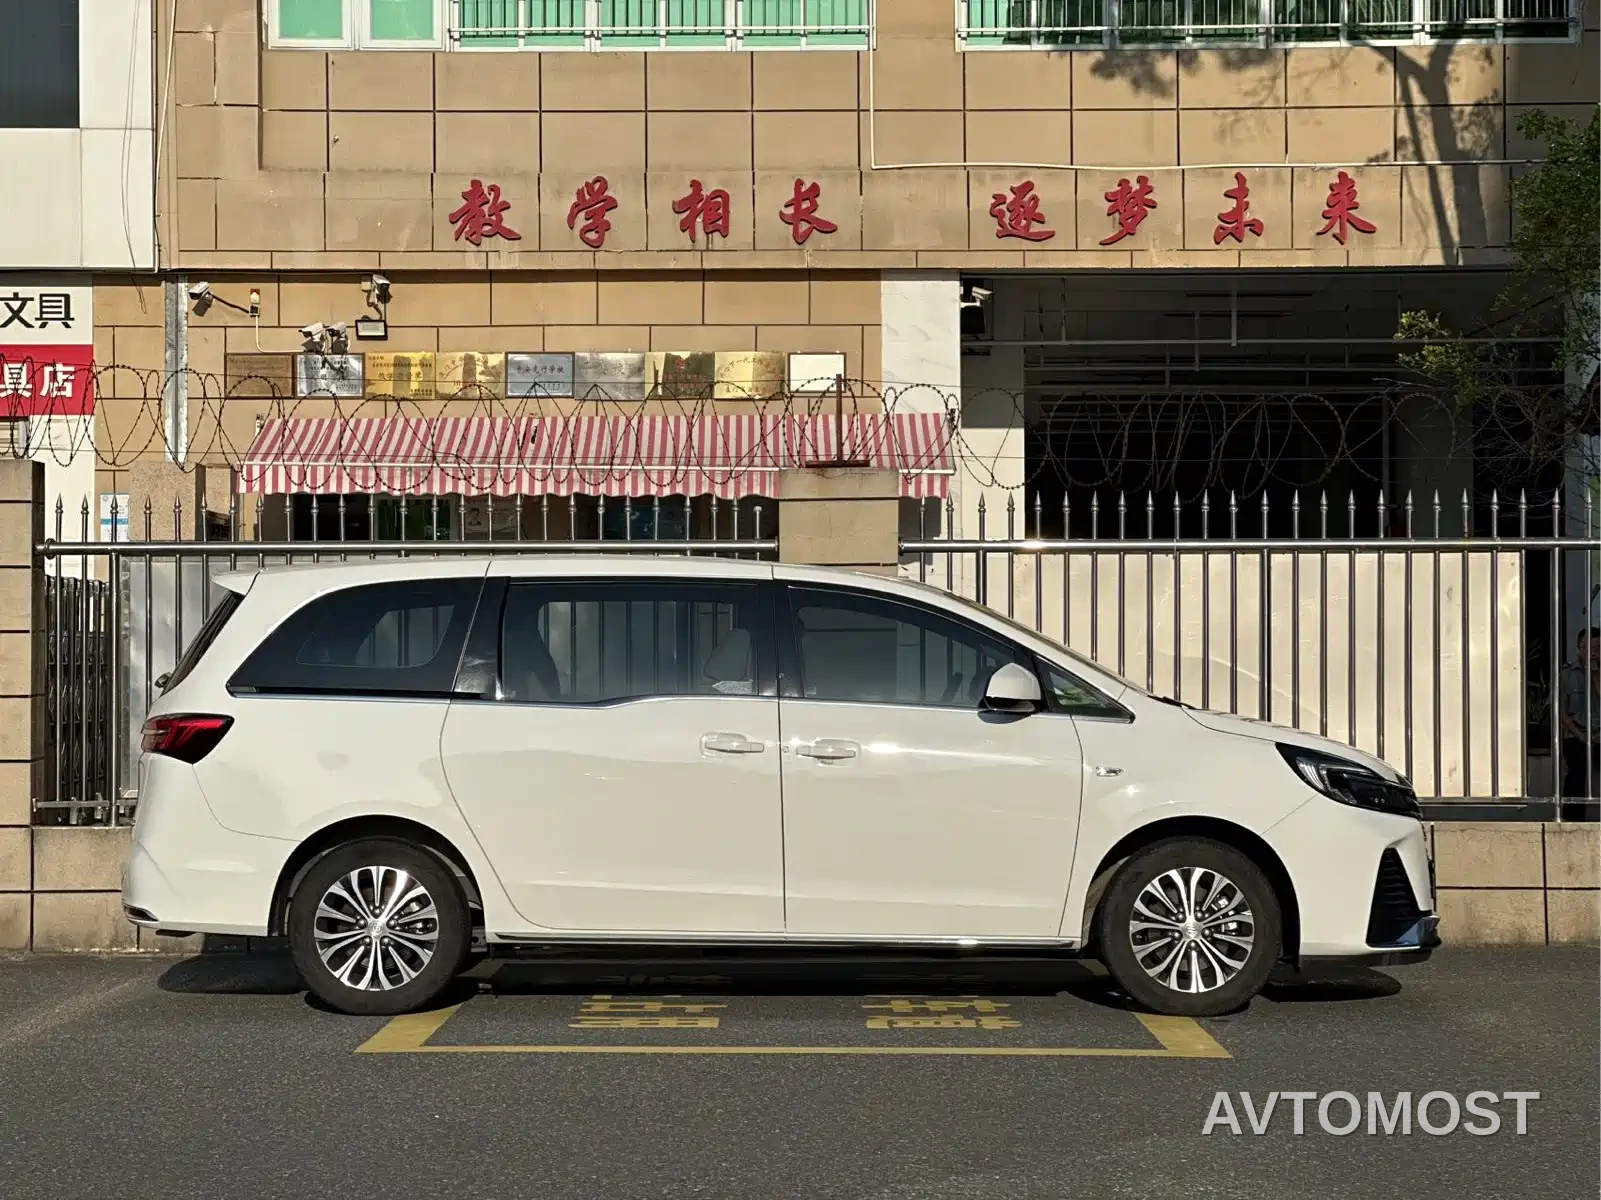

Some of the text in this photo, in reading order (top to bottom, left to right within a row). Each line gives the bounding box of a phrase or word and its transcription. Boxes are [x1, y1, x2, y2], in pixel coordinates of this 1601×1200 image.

[448, 171, 1378, 249] 教学相长 逐梦未来
[0, 291, 75, 329] 文具
[0, 362, 75, 398] 具店
